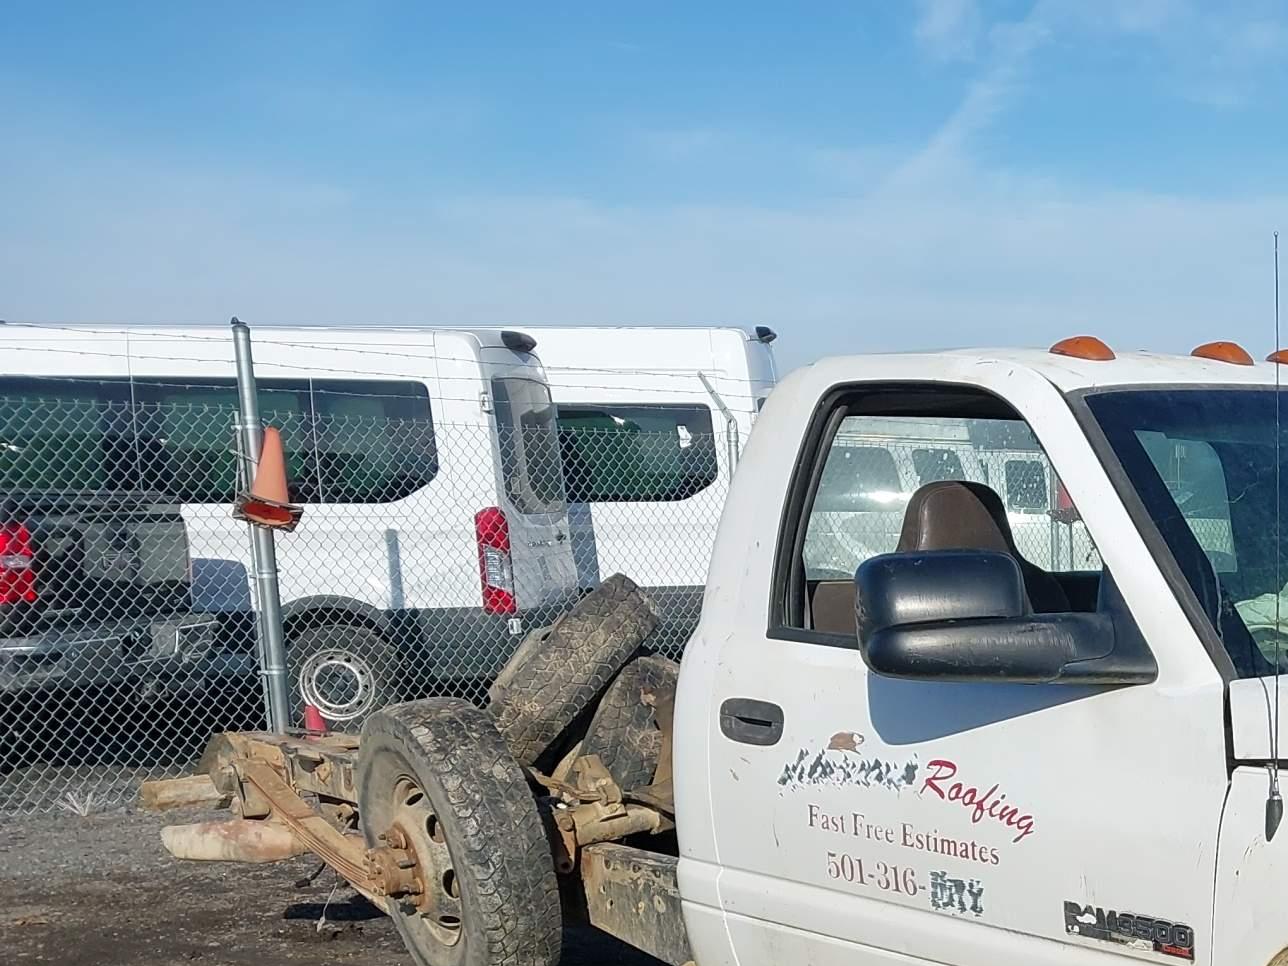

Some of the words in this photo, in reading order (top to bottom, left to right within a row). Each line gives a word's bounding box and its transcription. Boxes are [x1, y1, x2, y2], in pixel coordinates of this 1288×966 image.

[807, 803, 846, 834] Fast
[851, 812, 895, 844] Free
[901, 823, 1001, 866] Estimates
[920, 759, 1034, 843] Roofing
